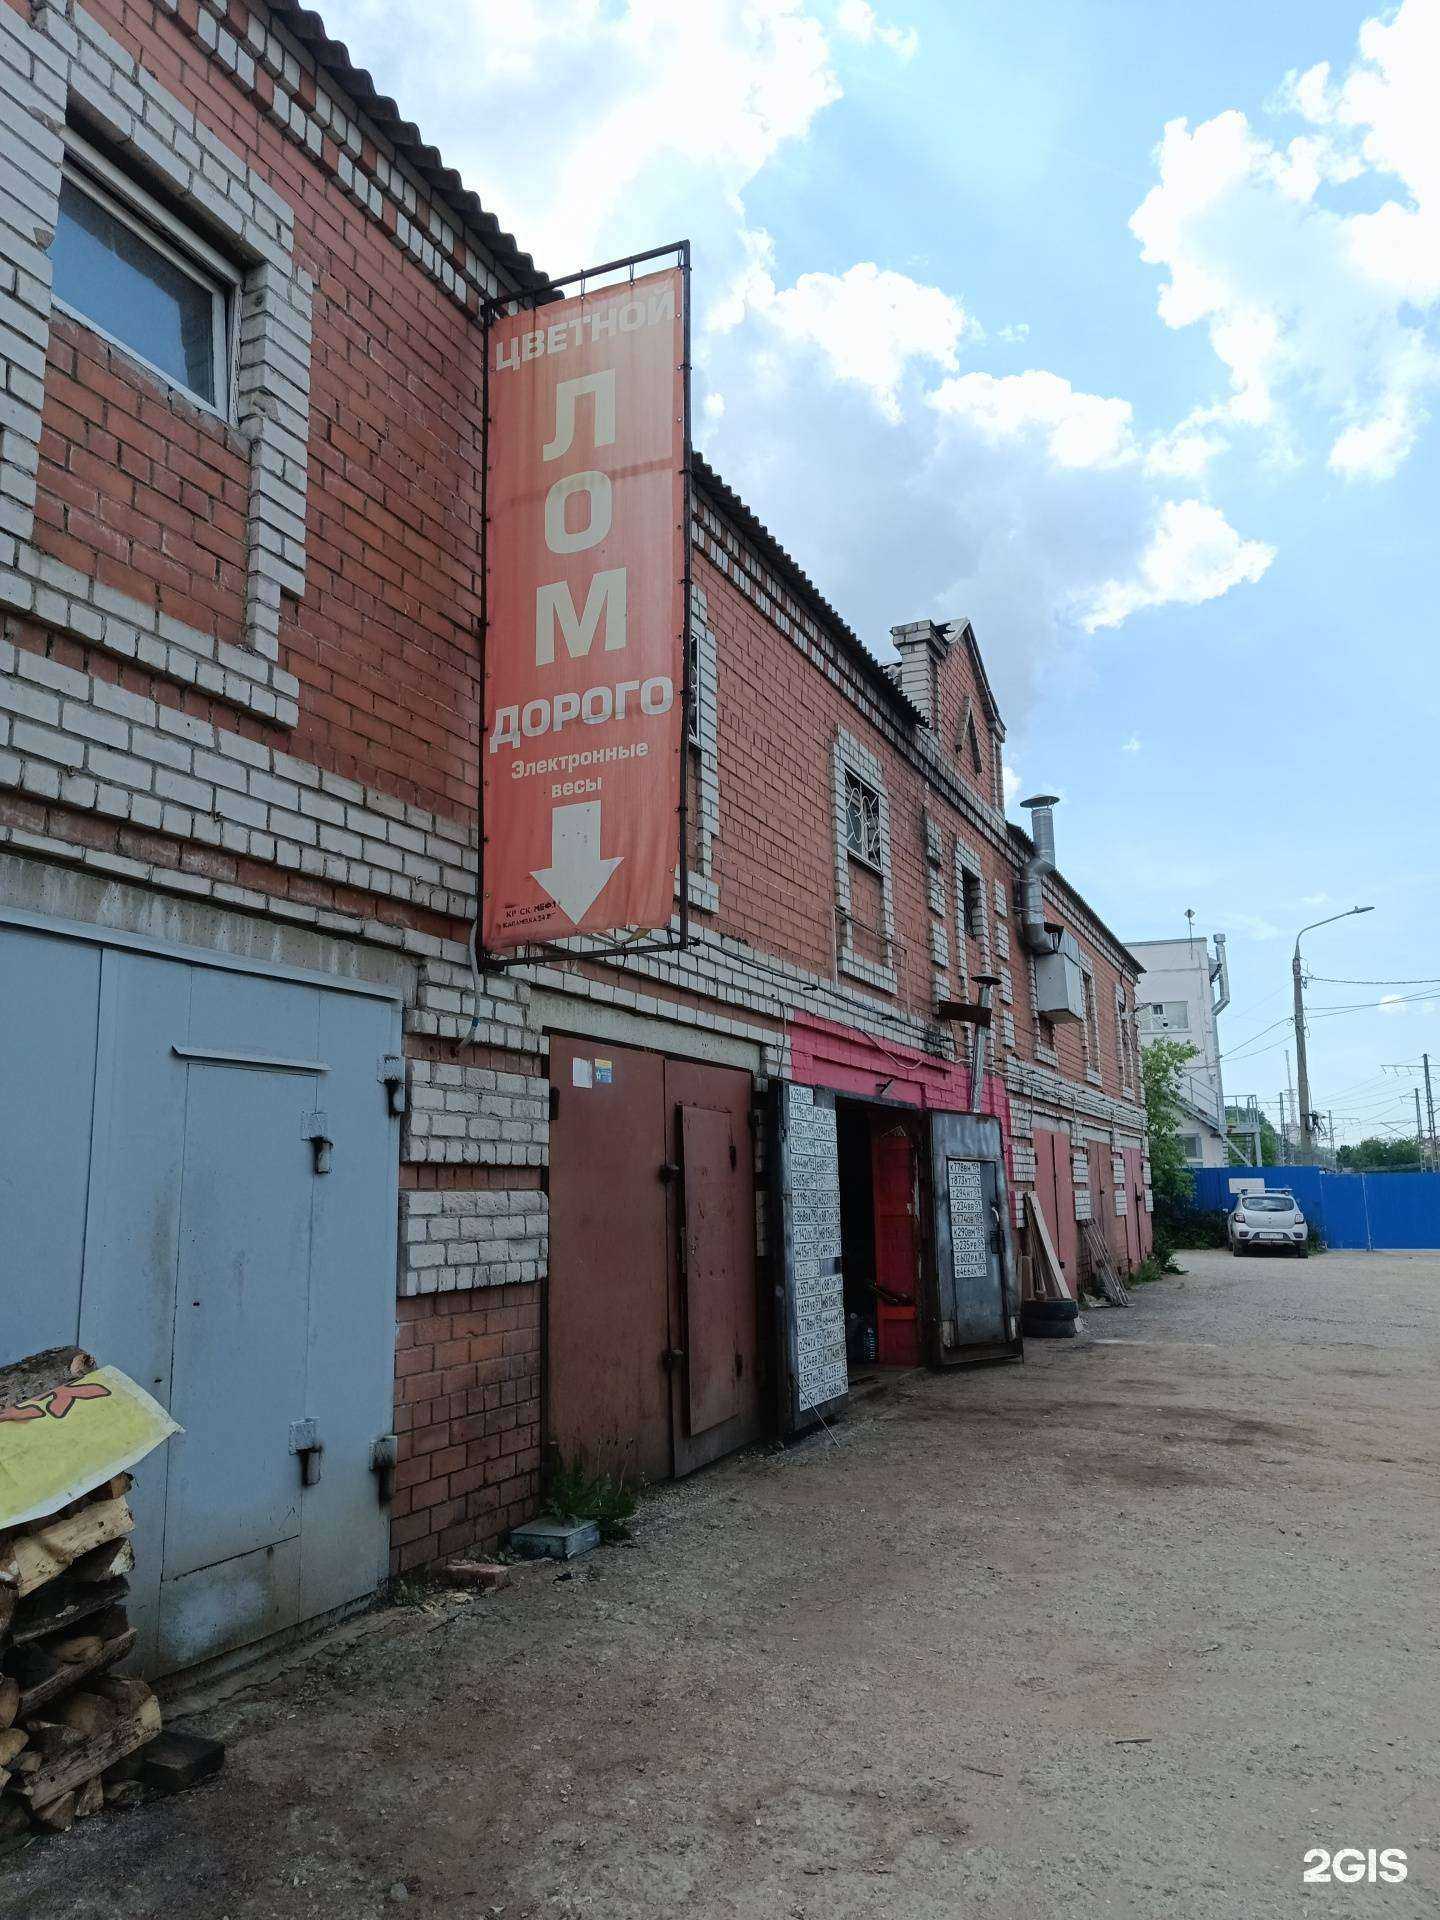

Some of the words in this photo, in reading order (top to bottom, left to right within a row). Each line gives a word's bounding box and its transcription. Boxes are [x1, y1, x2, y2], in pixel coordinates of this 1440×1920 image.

[496, 279, 675, 372] ЦВЕТНОЙ
[490, 676, 673, 753] ДОРОГО
[511, 742, 649, 779] Электронные
[551, 776, 602, 798] весы
